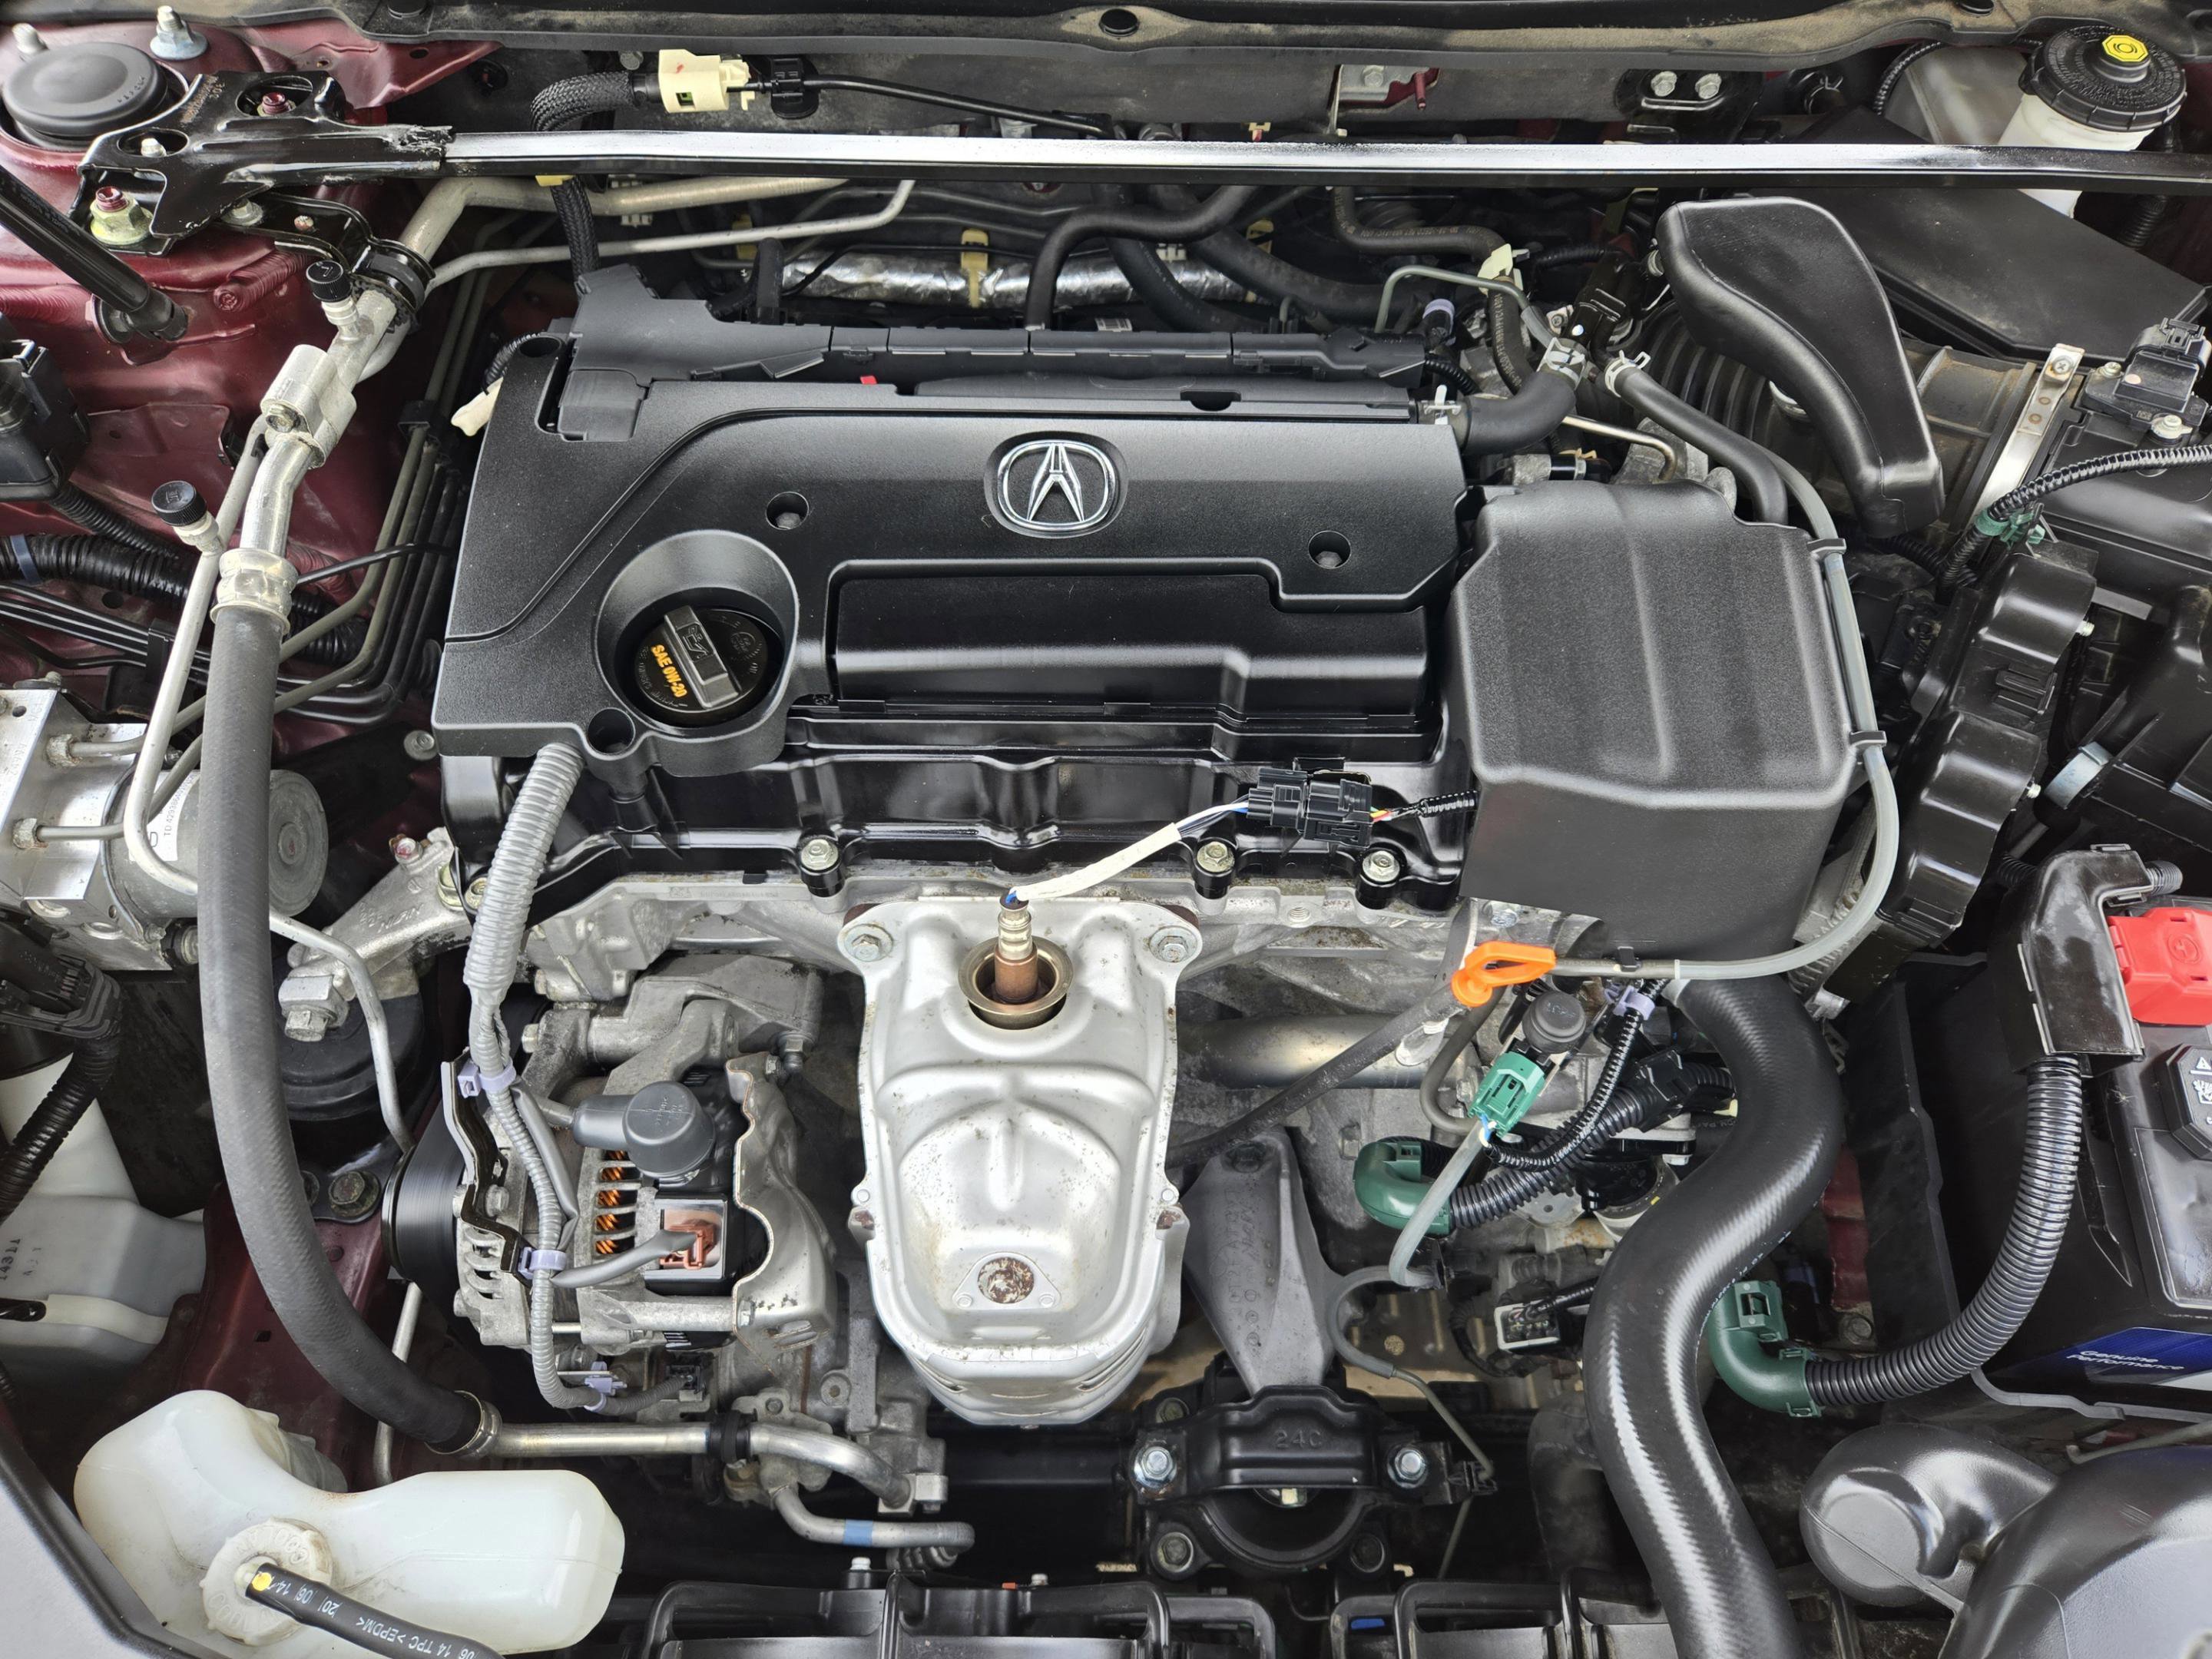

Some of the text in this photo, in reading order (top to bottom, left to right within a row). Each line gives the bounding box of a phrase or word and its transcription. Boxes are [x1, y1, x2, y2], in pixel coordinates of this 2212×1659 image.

[651, 644, 673, 667] SAE
[663, 665, 687, 697] 0W-20
[2066, 1354, 2184, 1370] Performance
[2080, 1350, 2159, 1363] Genuine
[1273, 1428, 1323, 1449] 24C
[356, 1617, 406, 1644] >EPDM<
[409, 1635, 434, 1654] TPC
[436, 1643, 452, 1657] 14
